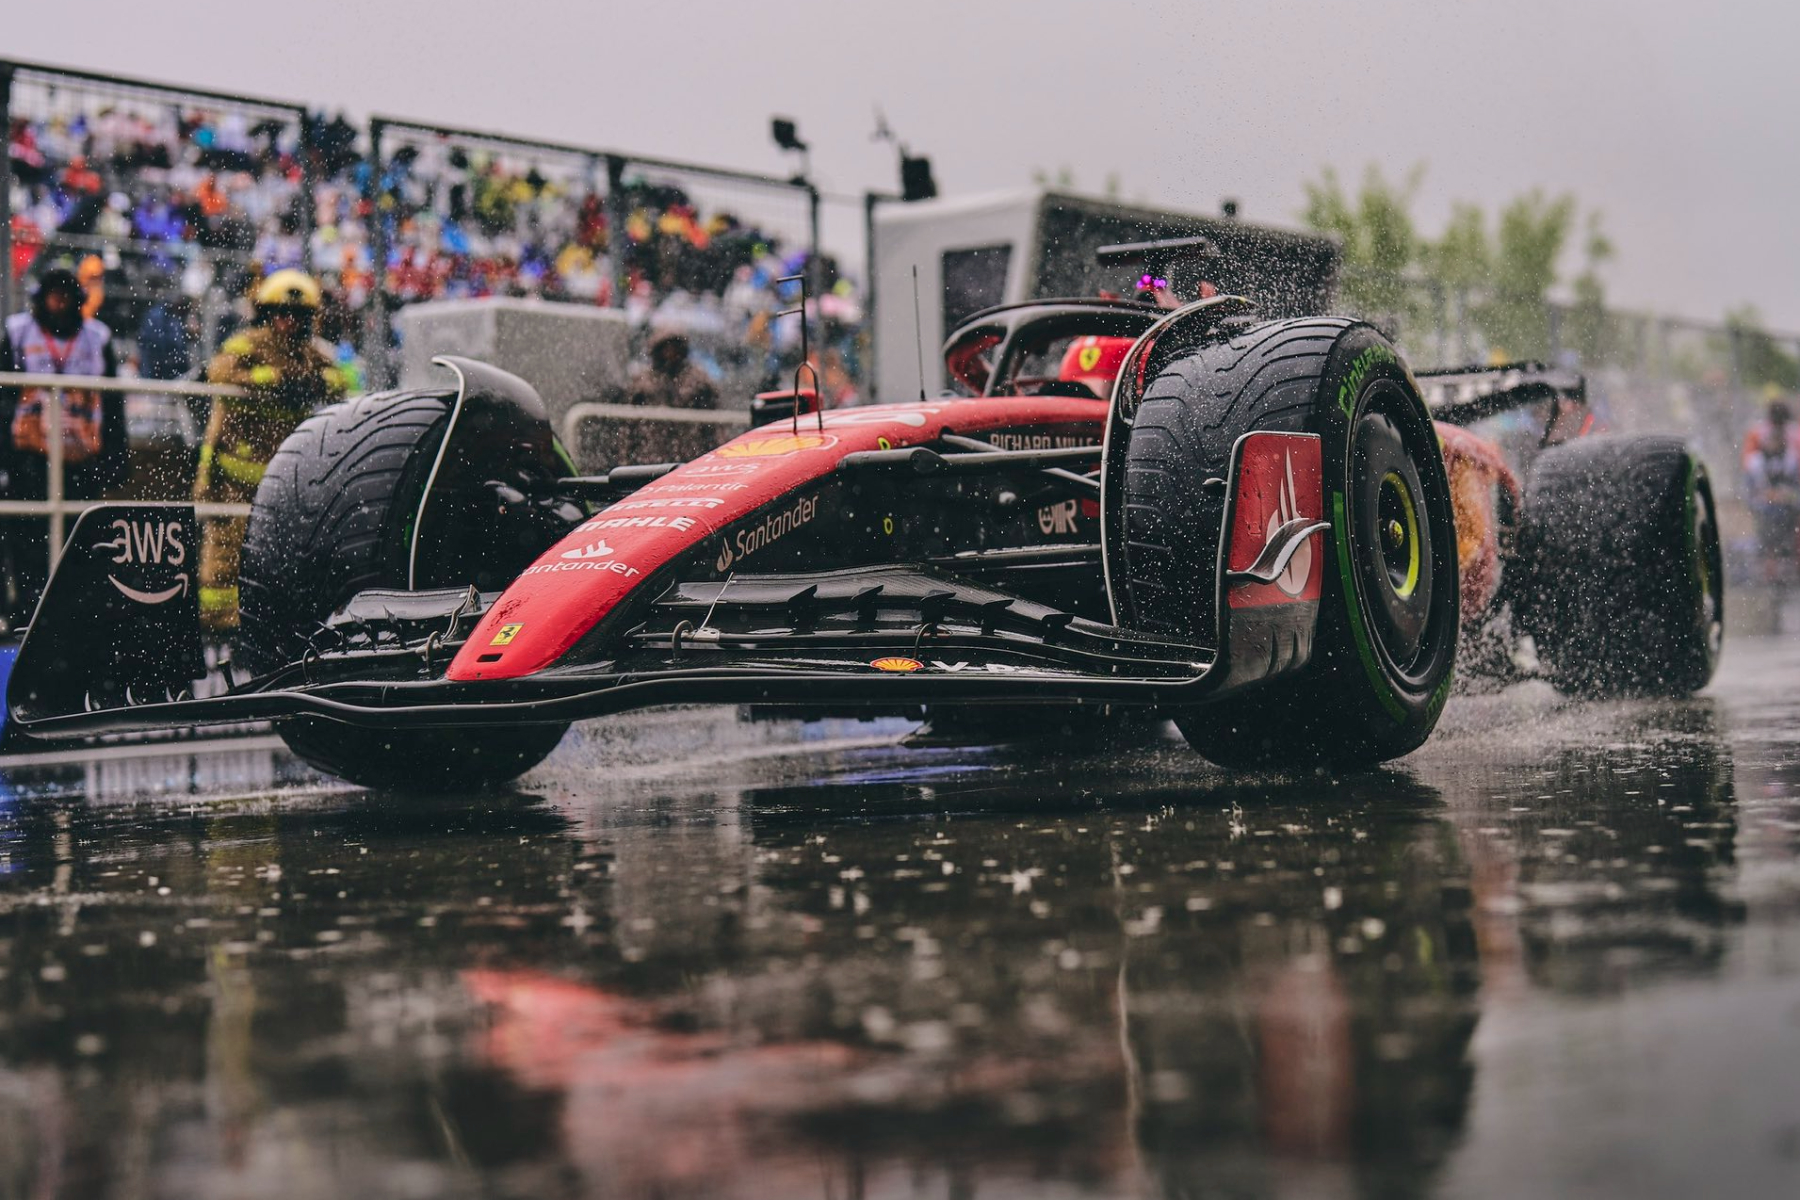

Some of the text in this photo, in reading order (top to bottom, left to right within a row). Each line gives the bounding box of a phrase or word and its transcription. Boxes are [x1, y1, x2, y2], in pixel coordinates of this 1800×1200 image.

[112, 519, 185, 565] aws
[736, 495, 818, 561] Santander
[521, 559, 640, 578] antander
